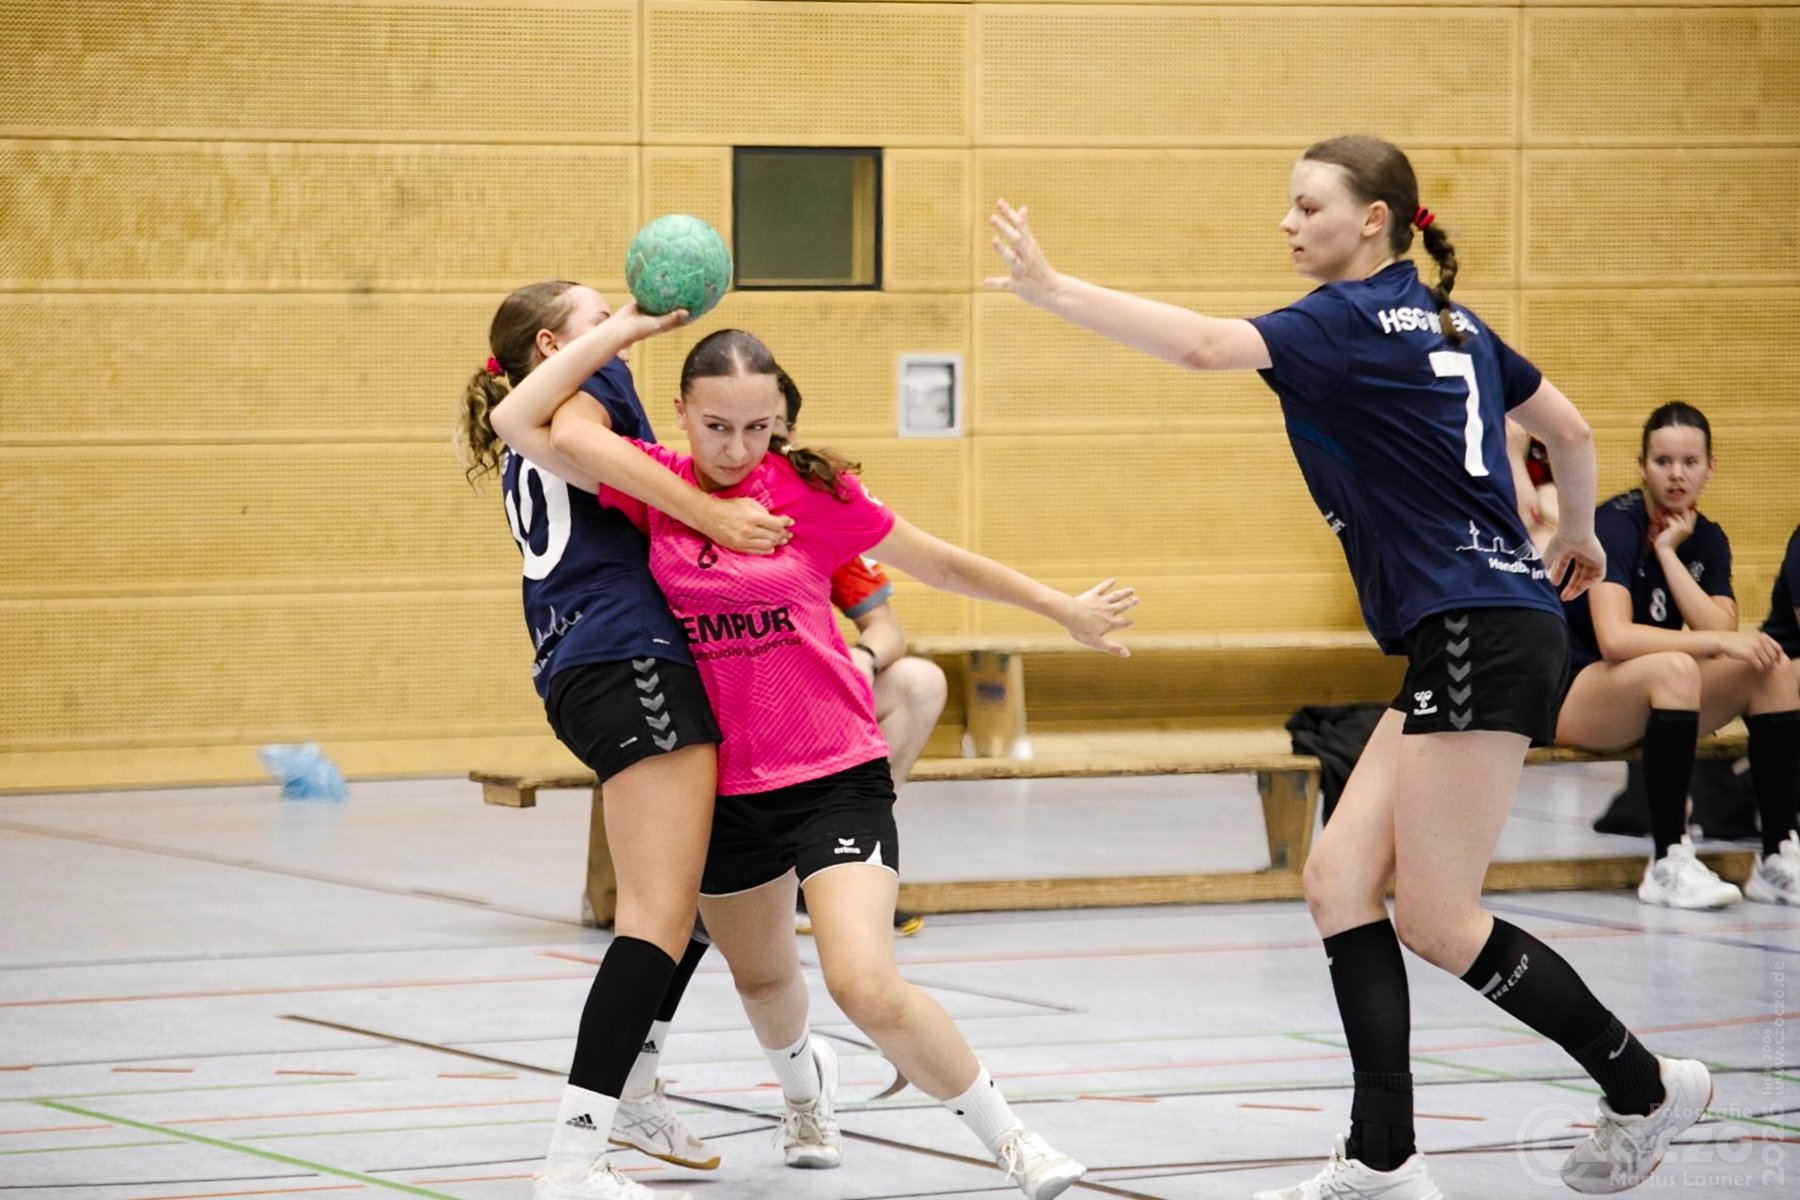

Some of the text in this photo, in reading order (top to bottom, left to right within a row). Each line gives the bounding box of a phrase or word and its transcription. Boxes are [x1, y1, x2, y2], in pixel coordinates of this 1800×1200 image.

[1428, 351, 1489, 477] 7
[698, 542, 718, 569] 6
[1650, 588, 1667, 622] 8
